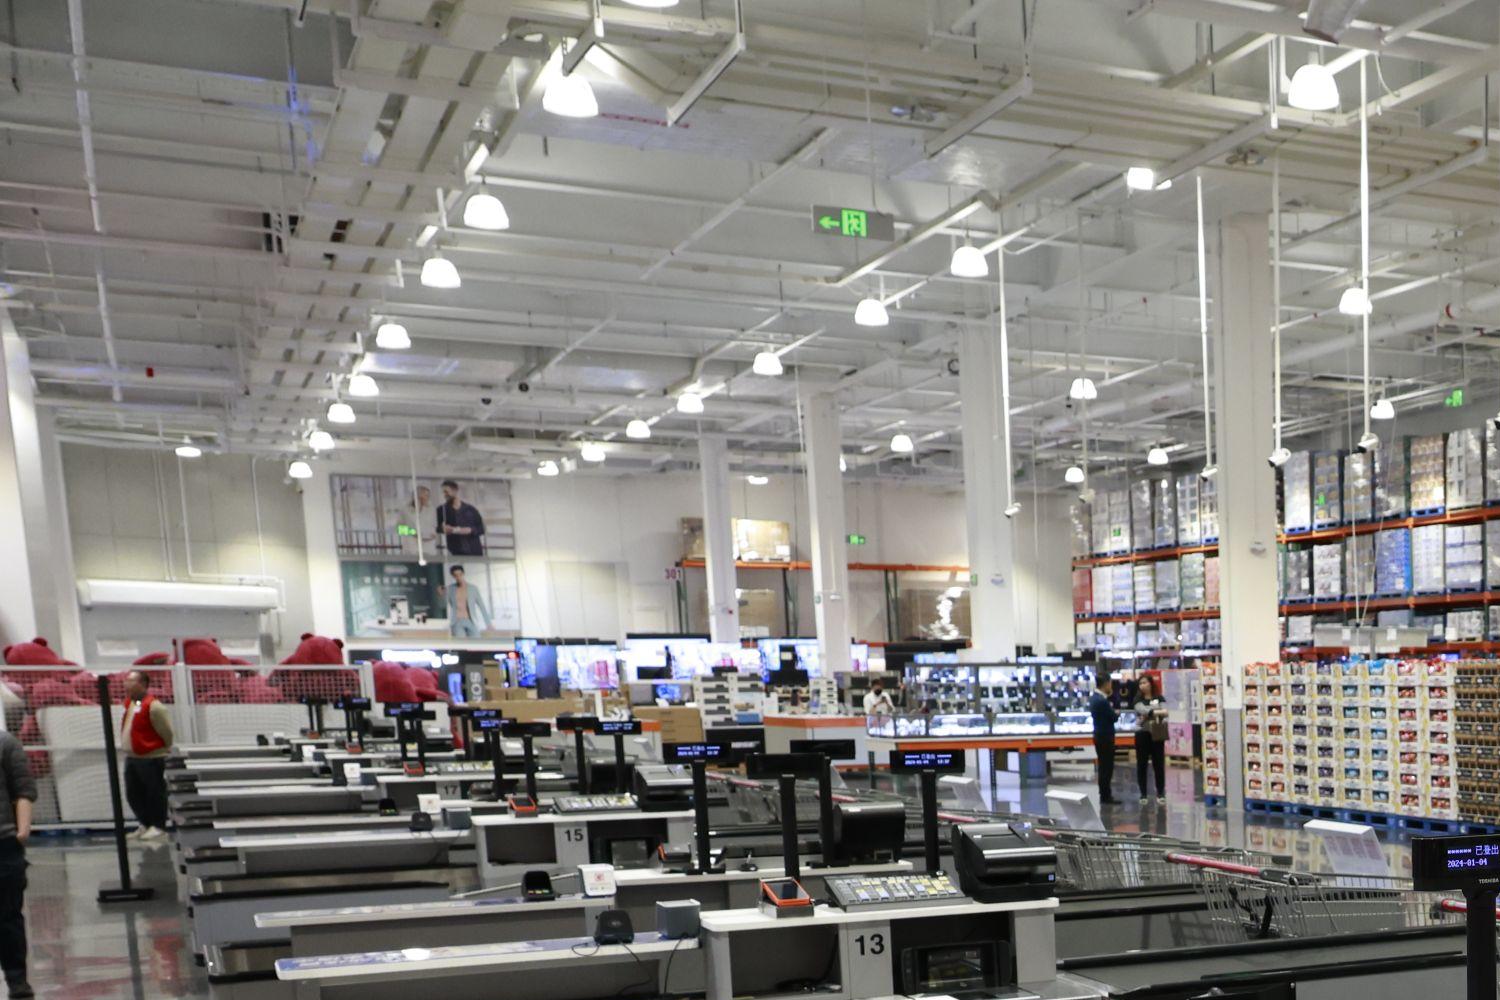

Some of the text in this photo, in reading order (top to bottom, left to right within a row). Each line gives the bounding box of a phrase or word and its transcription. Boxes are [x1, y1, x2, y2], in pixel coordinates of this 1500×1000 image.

[443, 784, 458, 795] 17
[565, 828, 584, 842] 15
[1475, 844, 1499, 856] 已登出
[1447, 857, 1488, 868] 2024-01-04
[1478, 877, 1500, 885] TOSHIBA
[854, 933, 885, 957] 13
